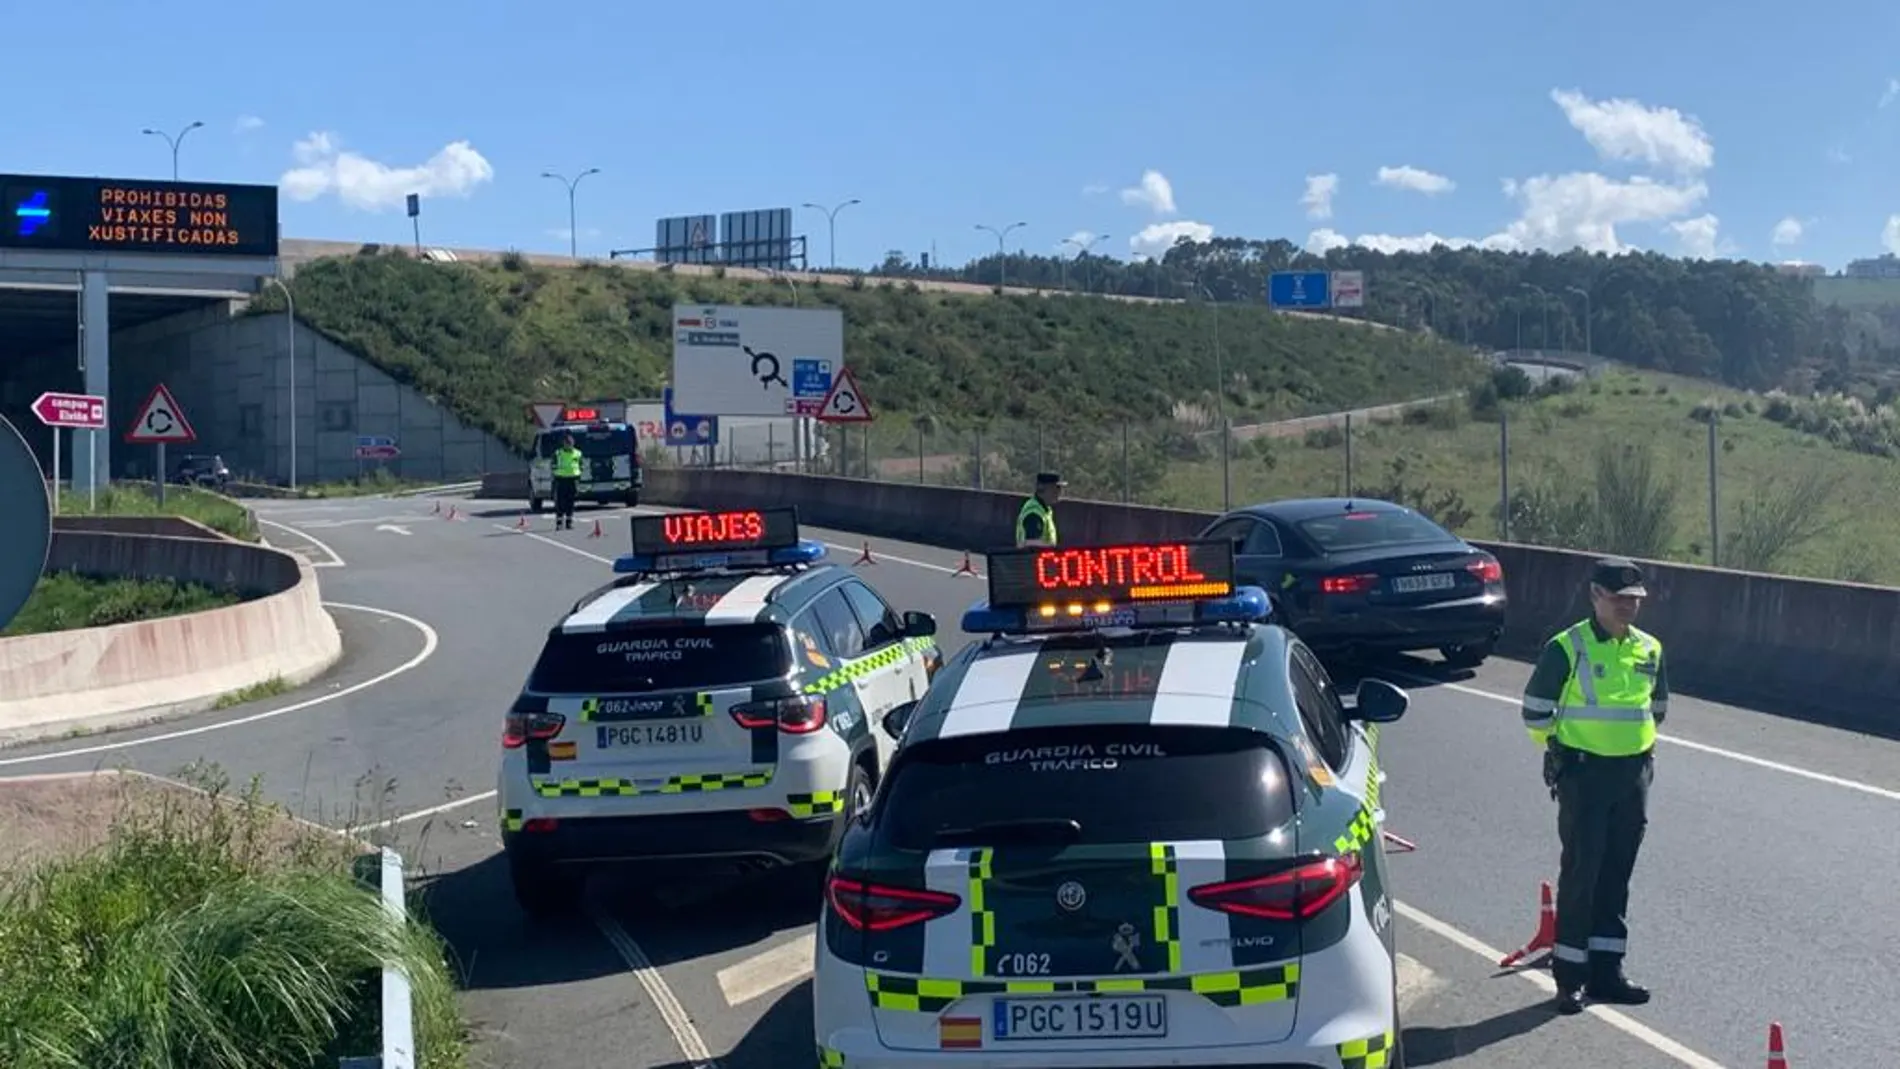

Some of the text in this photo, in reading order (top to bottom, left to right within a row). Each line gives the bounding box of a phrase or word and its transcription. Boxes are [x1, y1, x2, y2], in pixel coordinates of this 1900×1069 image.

[101, 188, 227, 209] PROHIBIDAS
[101, 207, 227, 227] VIAXES NON
[88, 225, 239, 245] XUSTIFICADAS
[664, 512, 763, 543] VIAJES
[1037, 545, 1205, 588] CONTROL
[596, 637, 714, 655] GUARDIA CIVIL
[606, 700, 630, 713] 062
[984, 743, 1167, 764] GUARDIA CIVIL
[1013, 952, 1051, 974] 062
